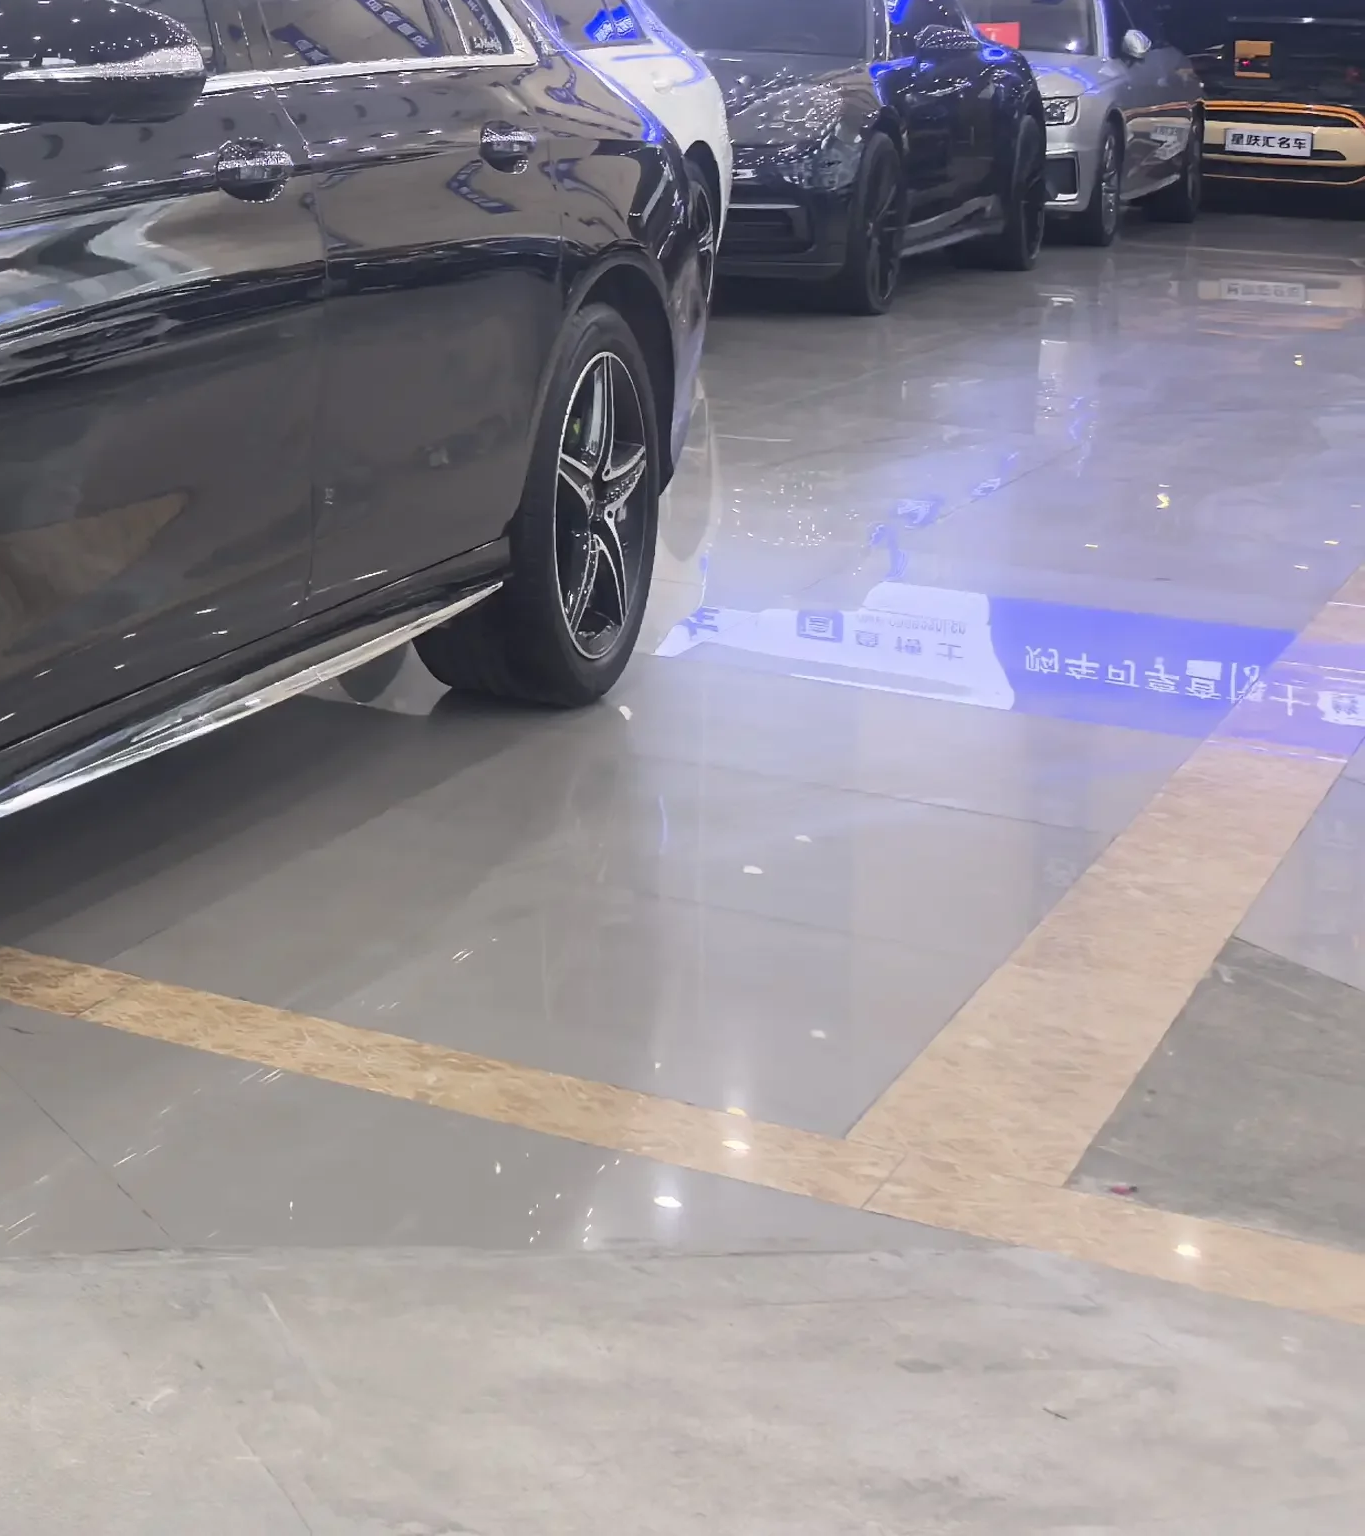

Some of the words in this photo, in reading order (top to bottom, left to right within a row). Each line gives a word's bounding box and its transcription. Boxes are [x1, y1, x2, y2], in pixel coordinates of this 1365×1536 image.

[1231, 133, 1307, 150] 星跃汇名车
